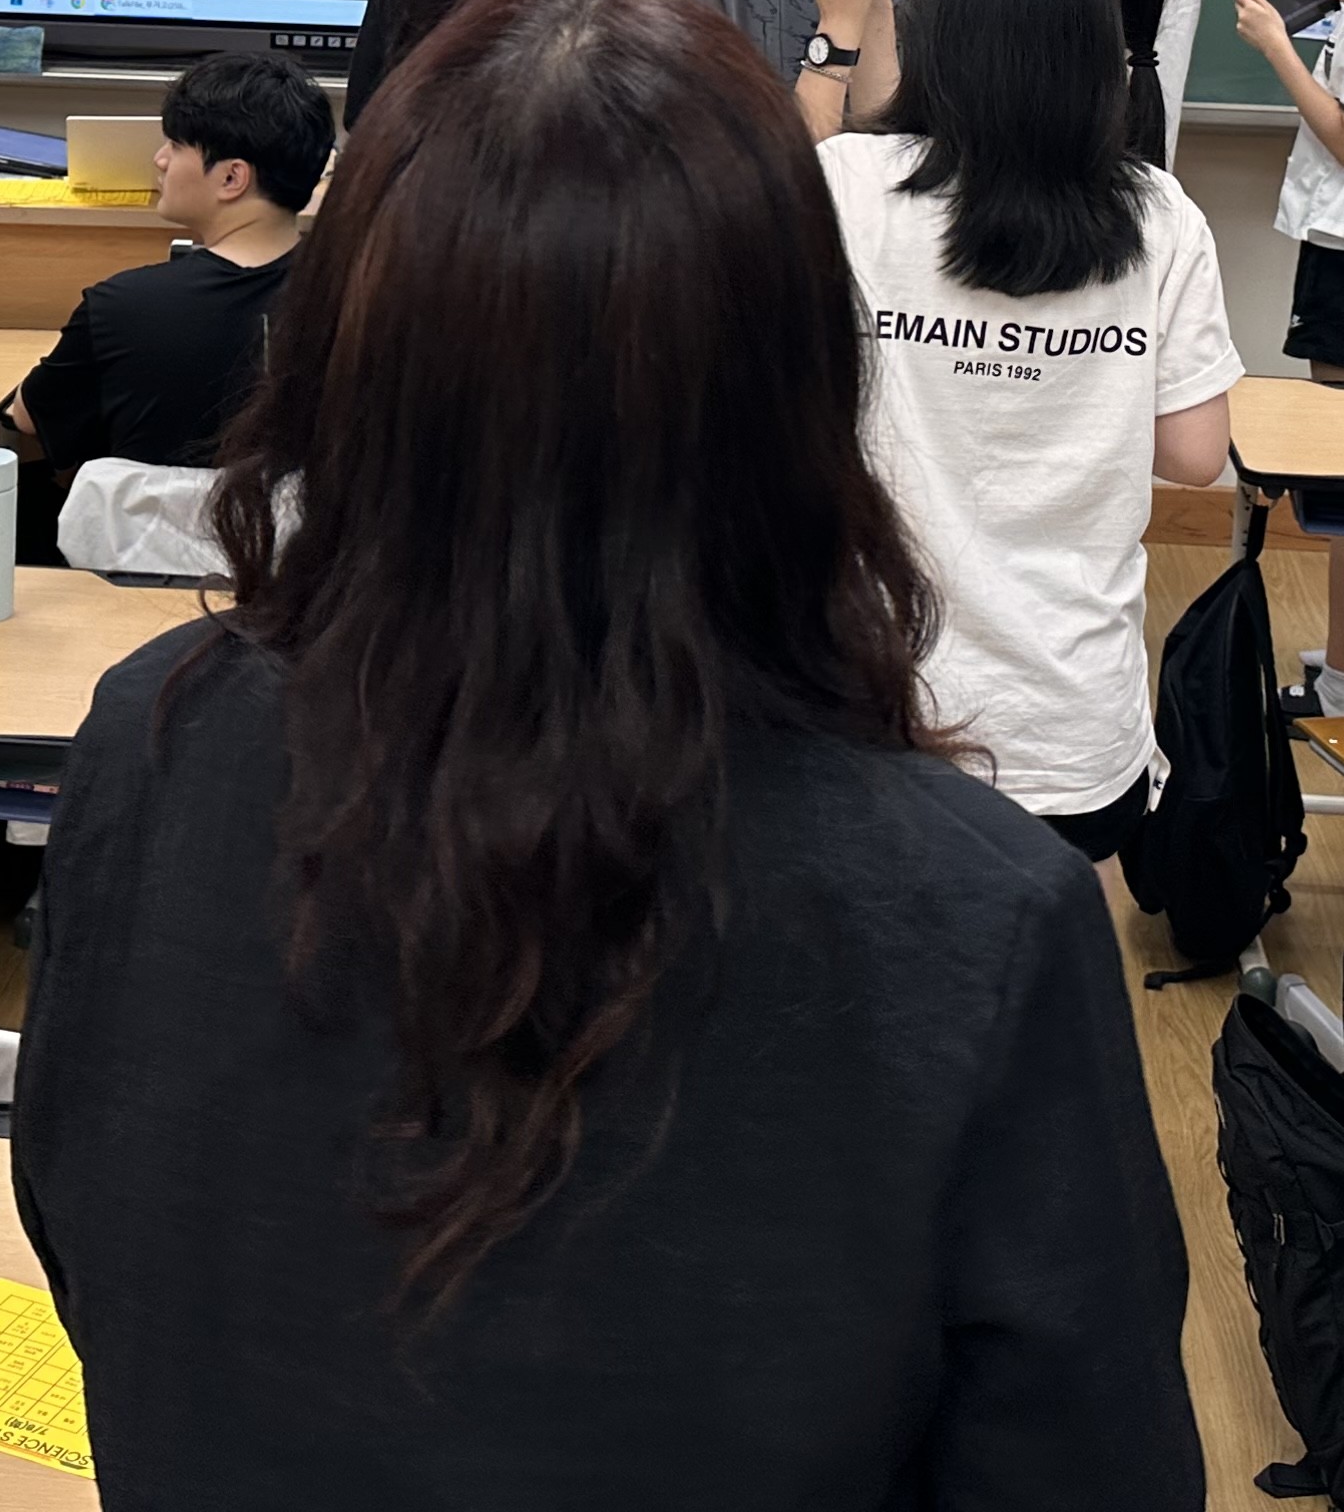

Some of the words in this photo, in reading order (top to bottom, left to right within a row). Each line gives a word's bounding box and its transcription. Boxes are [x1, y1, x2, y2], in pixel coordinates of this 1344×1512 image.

[875, 310, 988, 349] EMAIN
[998, 322, 1148, 357] STUDIOS
[953, 361, 1003, 377] PARIS
[1006, 365, 1042, 381] 1992
[15, 1435, 95, 1466] SCIENCE
